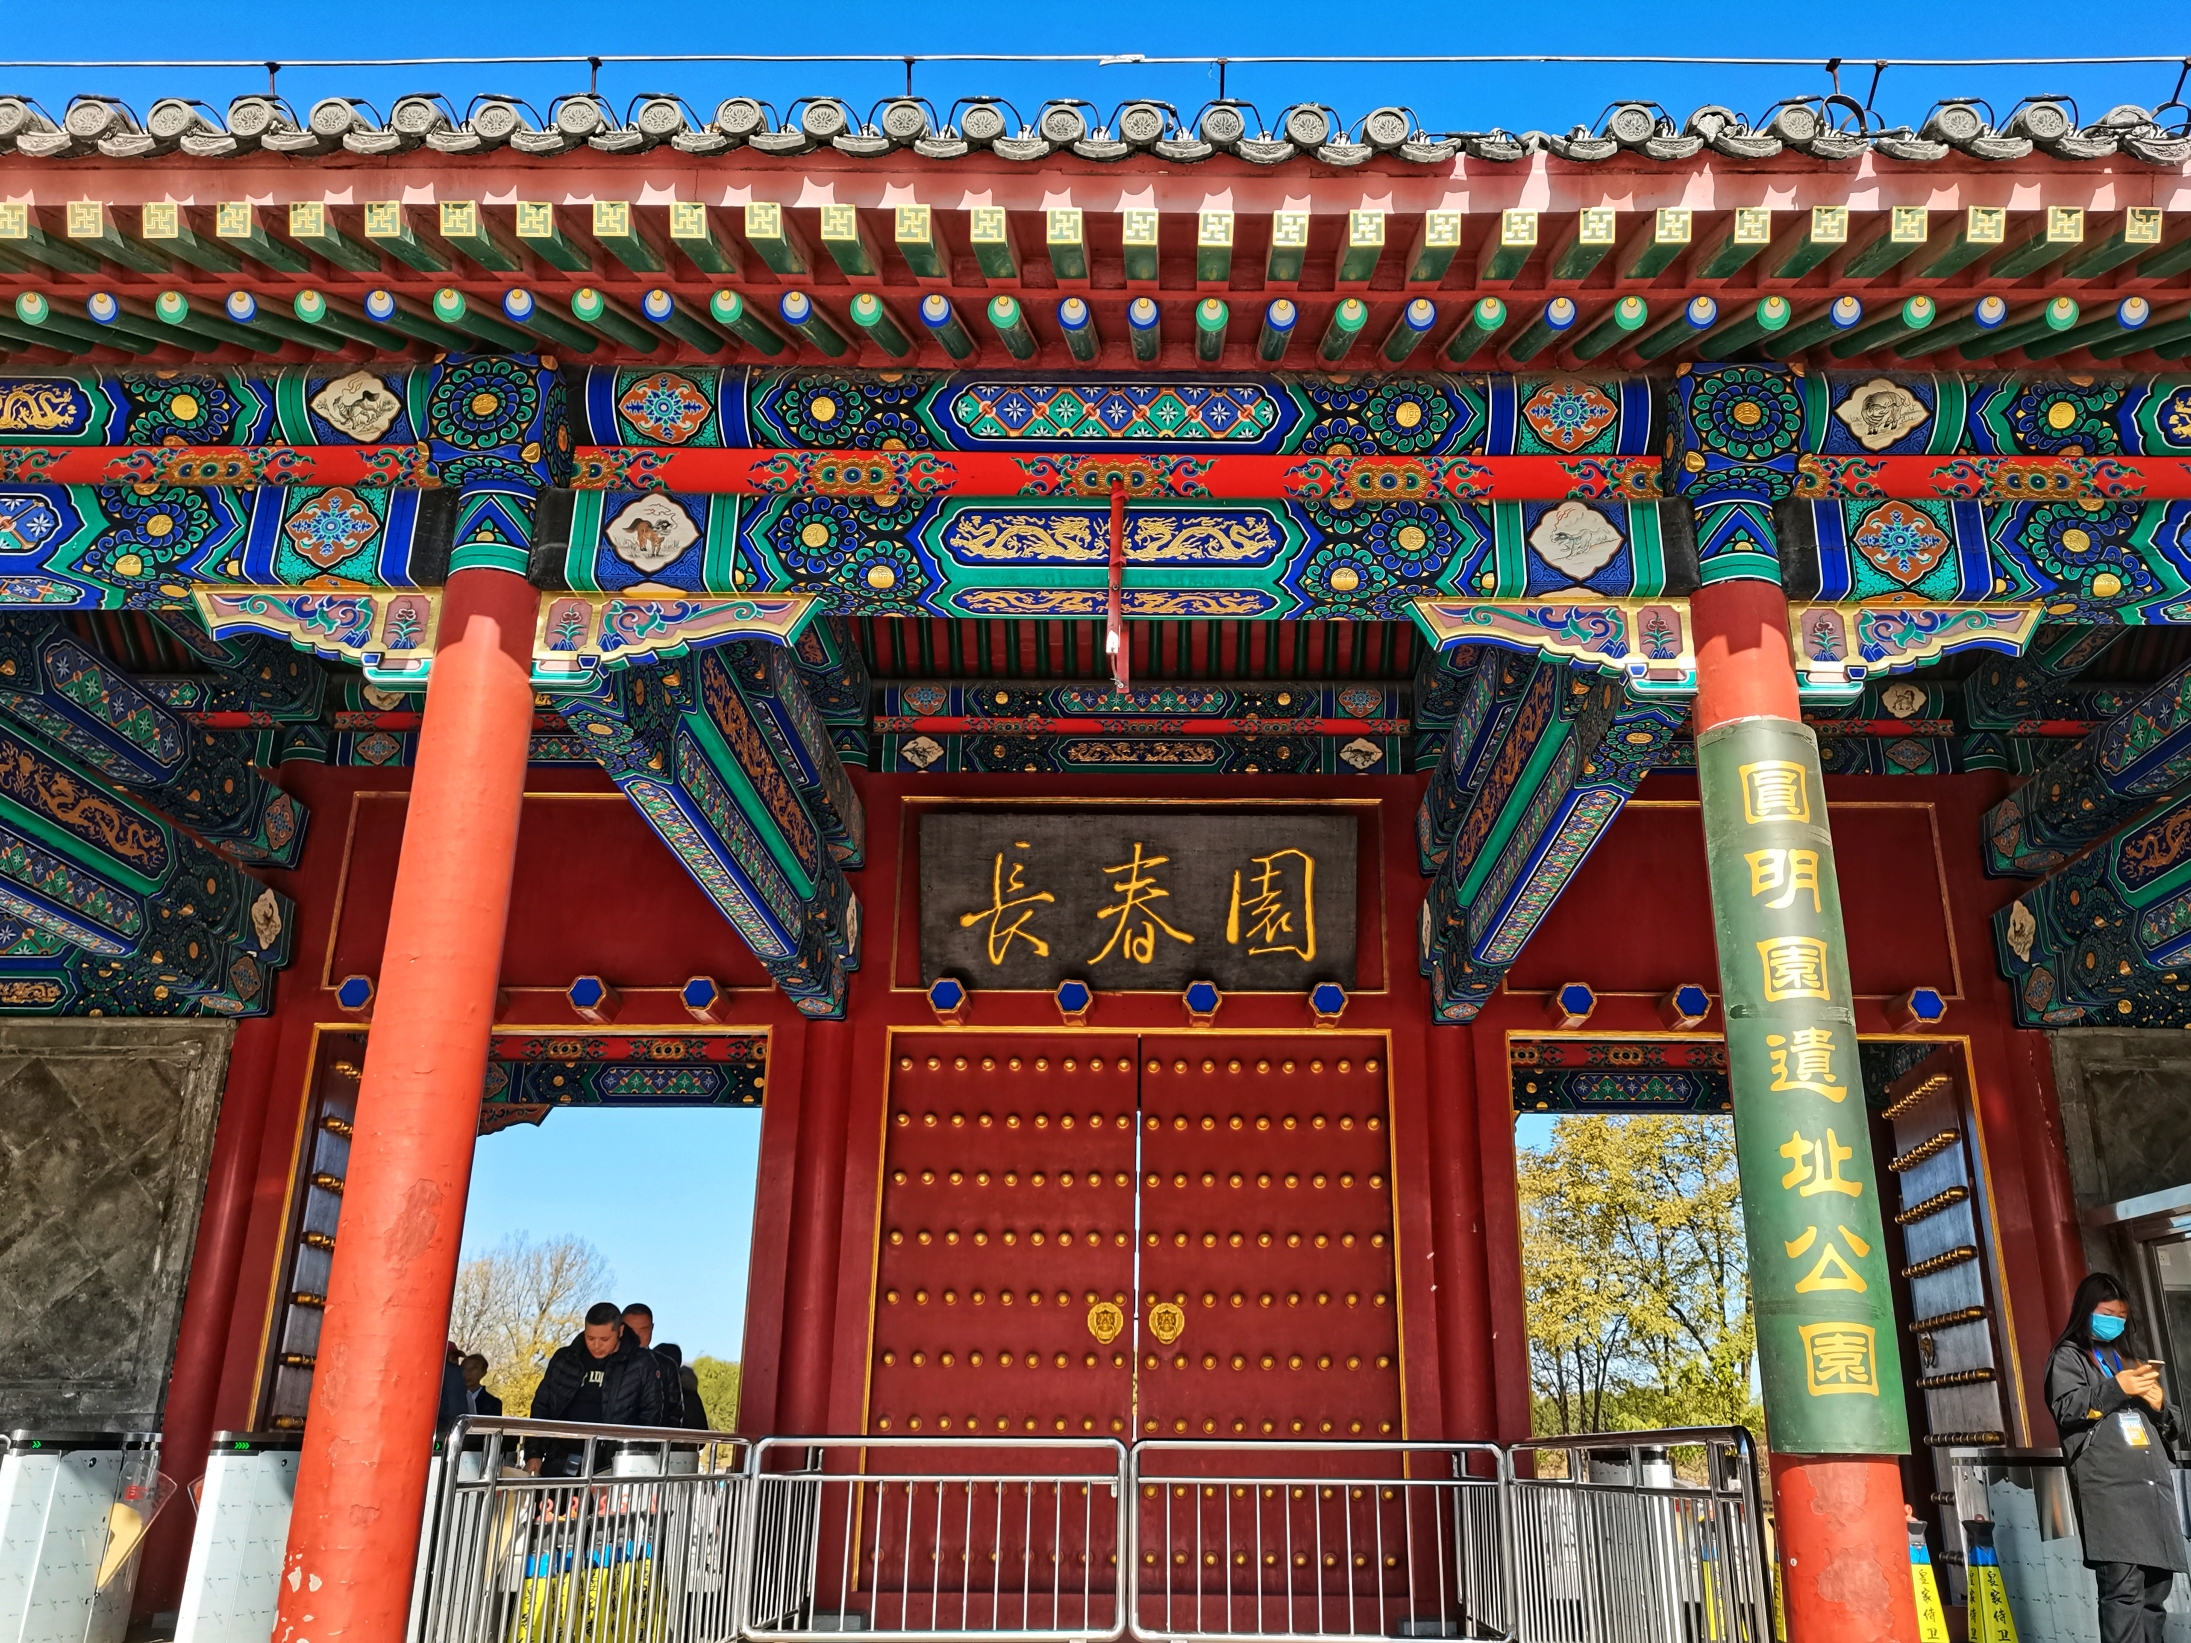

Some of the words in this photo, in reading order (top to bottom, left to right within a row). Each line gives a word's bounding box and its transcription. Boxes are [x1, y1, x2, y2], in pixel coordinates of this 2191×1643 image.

[960, 841, 1316, 966] 長春園
[1738, 759, 1880, 1397] 圓明園遺址公園
[1918, 1568, 1940, 1640] 皇家侍卫
[1987, 1570, 2012, 1642] 皇家侍卫
